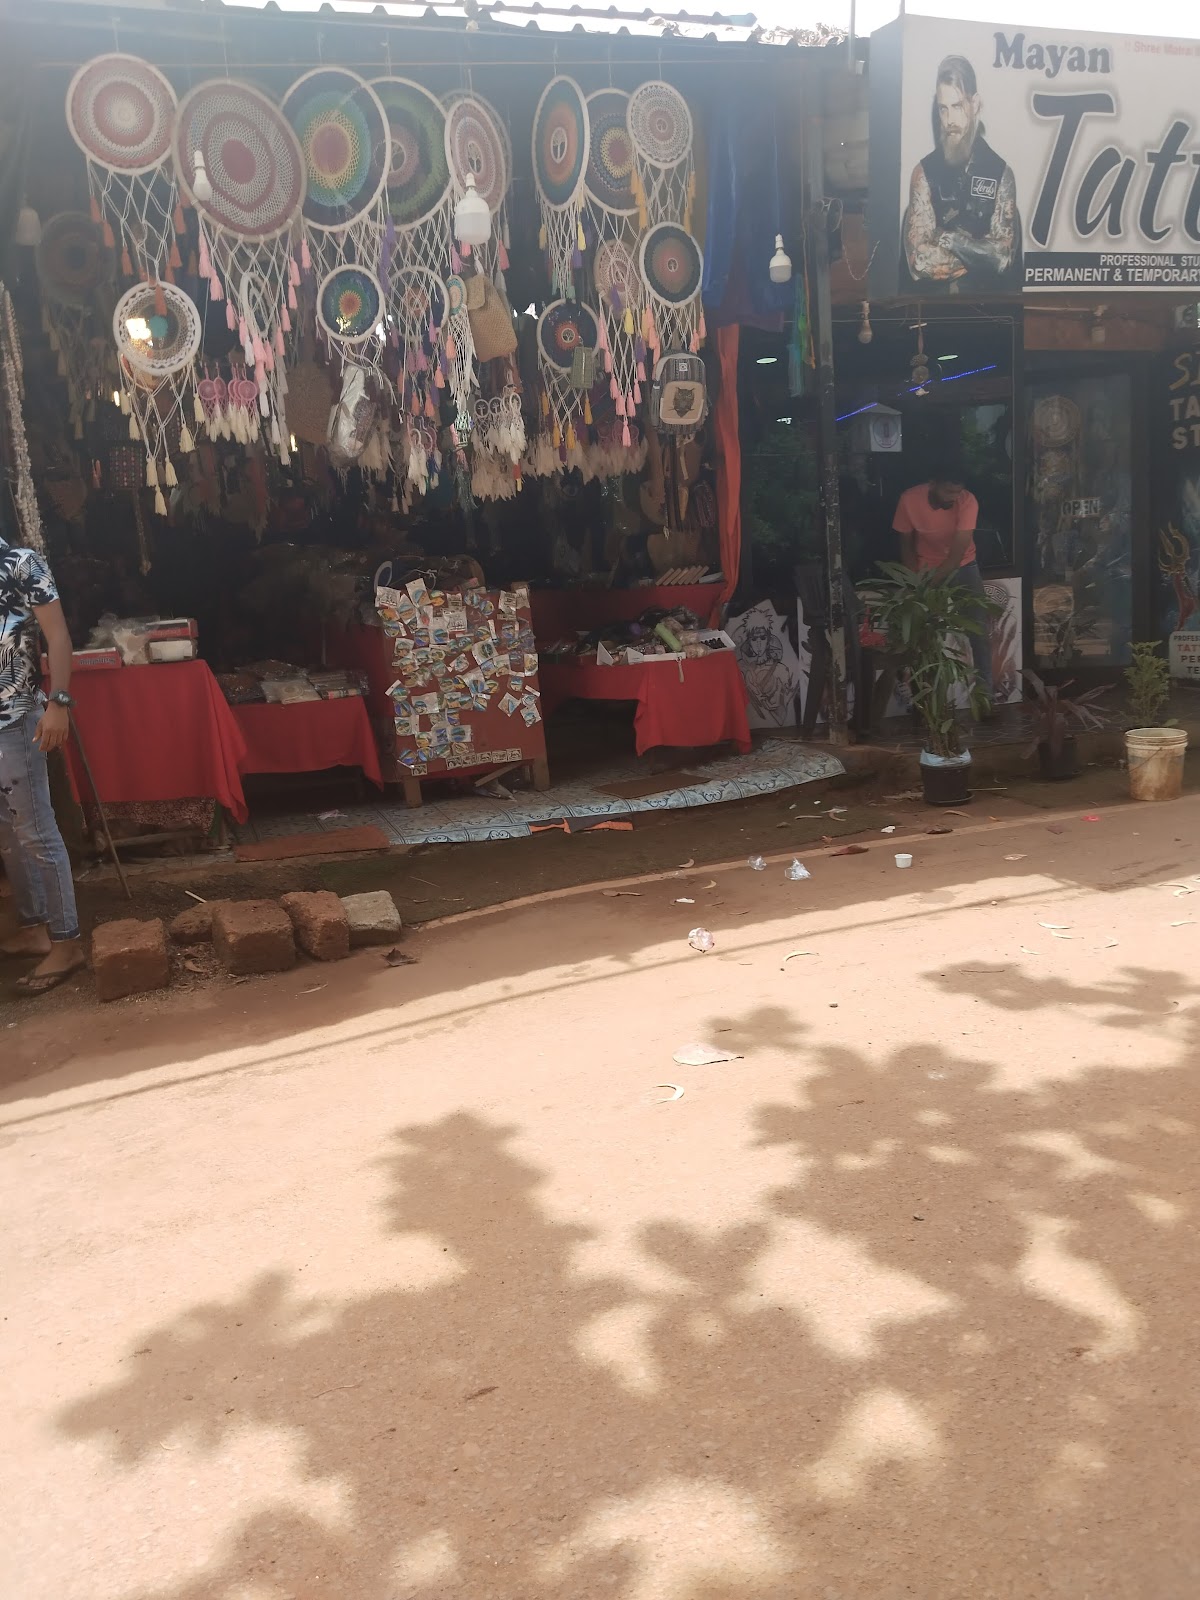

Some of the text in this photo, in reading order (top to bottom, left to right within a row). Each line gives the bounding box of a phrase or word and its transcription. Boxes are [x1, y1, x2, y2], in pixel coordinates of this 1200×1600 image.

[992, 31, 1111, 78] Mayan
[1100, 255, 1176, 267] PROFESSIONAL
[1025, 268, 1110, 282] PERMANENT
[1113, 269, 1123, 282] &
[1169, 395, 1200, 420] TA
[1063, 499, 1099, 516] OPEN
